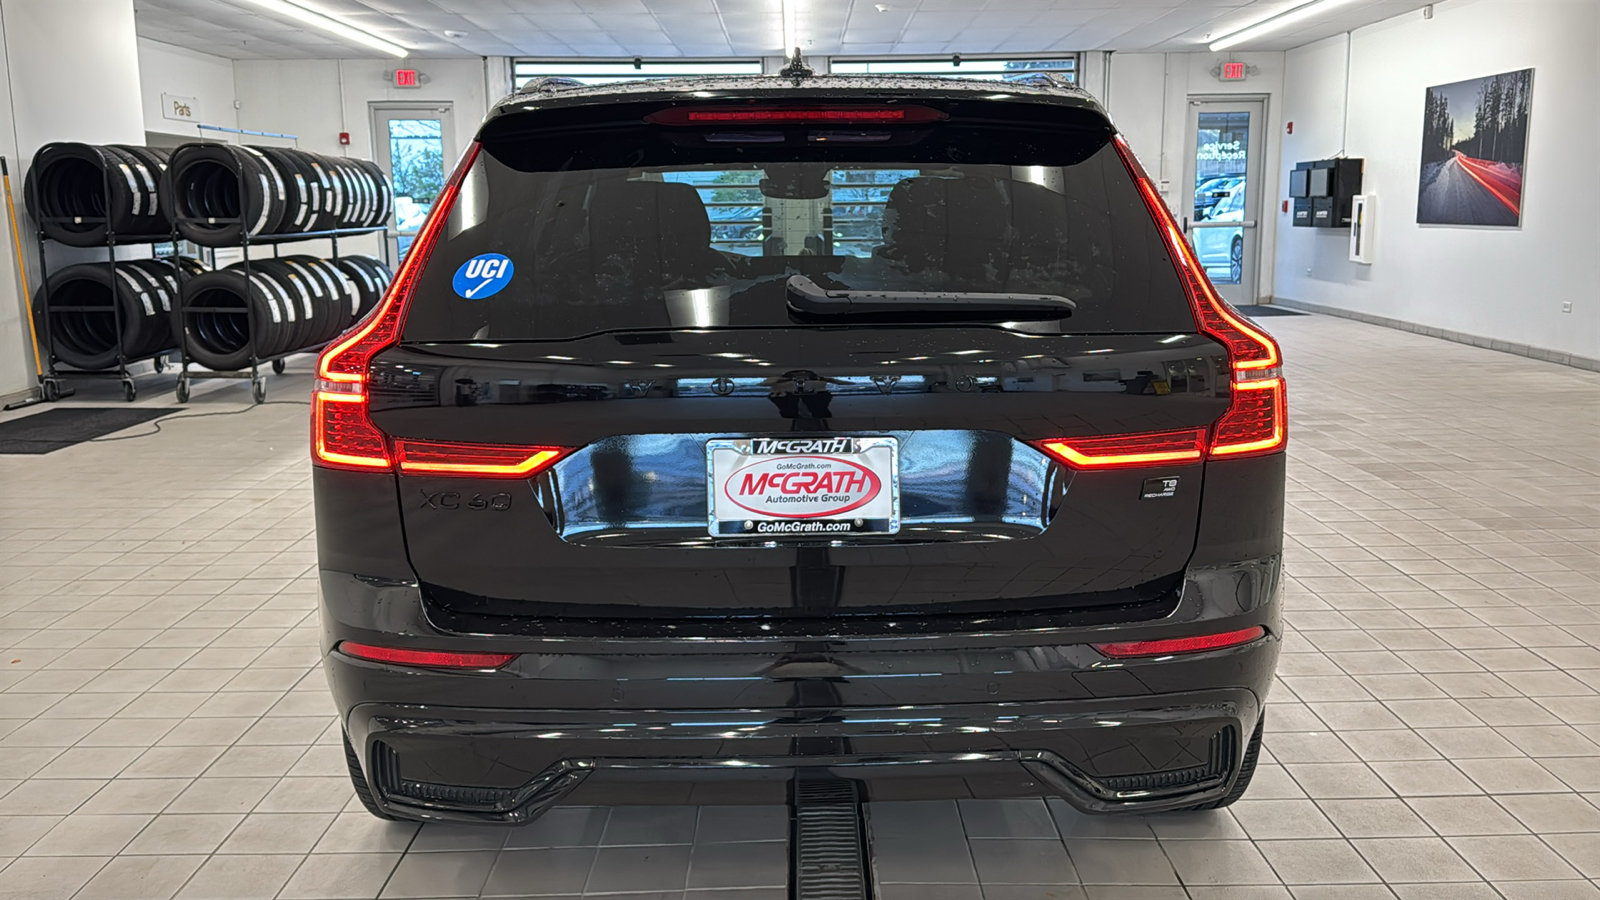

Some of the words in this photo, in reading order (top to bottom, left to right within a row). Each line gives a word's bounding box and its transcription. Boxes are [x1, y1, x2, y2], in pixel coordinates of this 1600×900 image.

[396, 69, 416, 86] EXIT
[1224, 62, 1244, 79] EXIT
[173, 100, 192, 117] Parts
[465, 258, 510, 279] UCI
[776, 462, 832, 471] GoMcGrath.com
[765, 494, 819, 504] Automotive
[820, 493, 851, 504] Group
[757, 520, 851, 533] GoMcGrath.com
